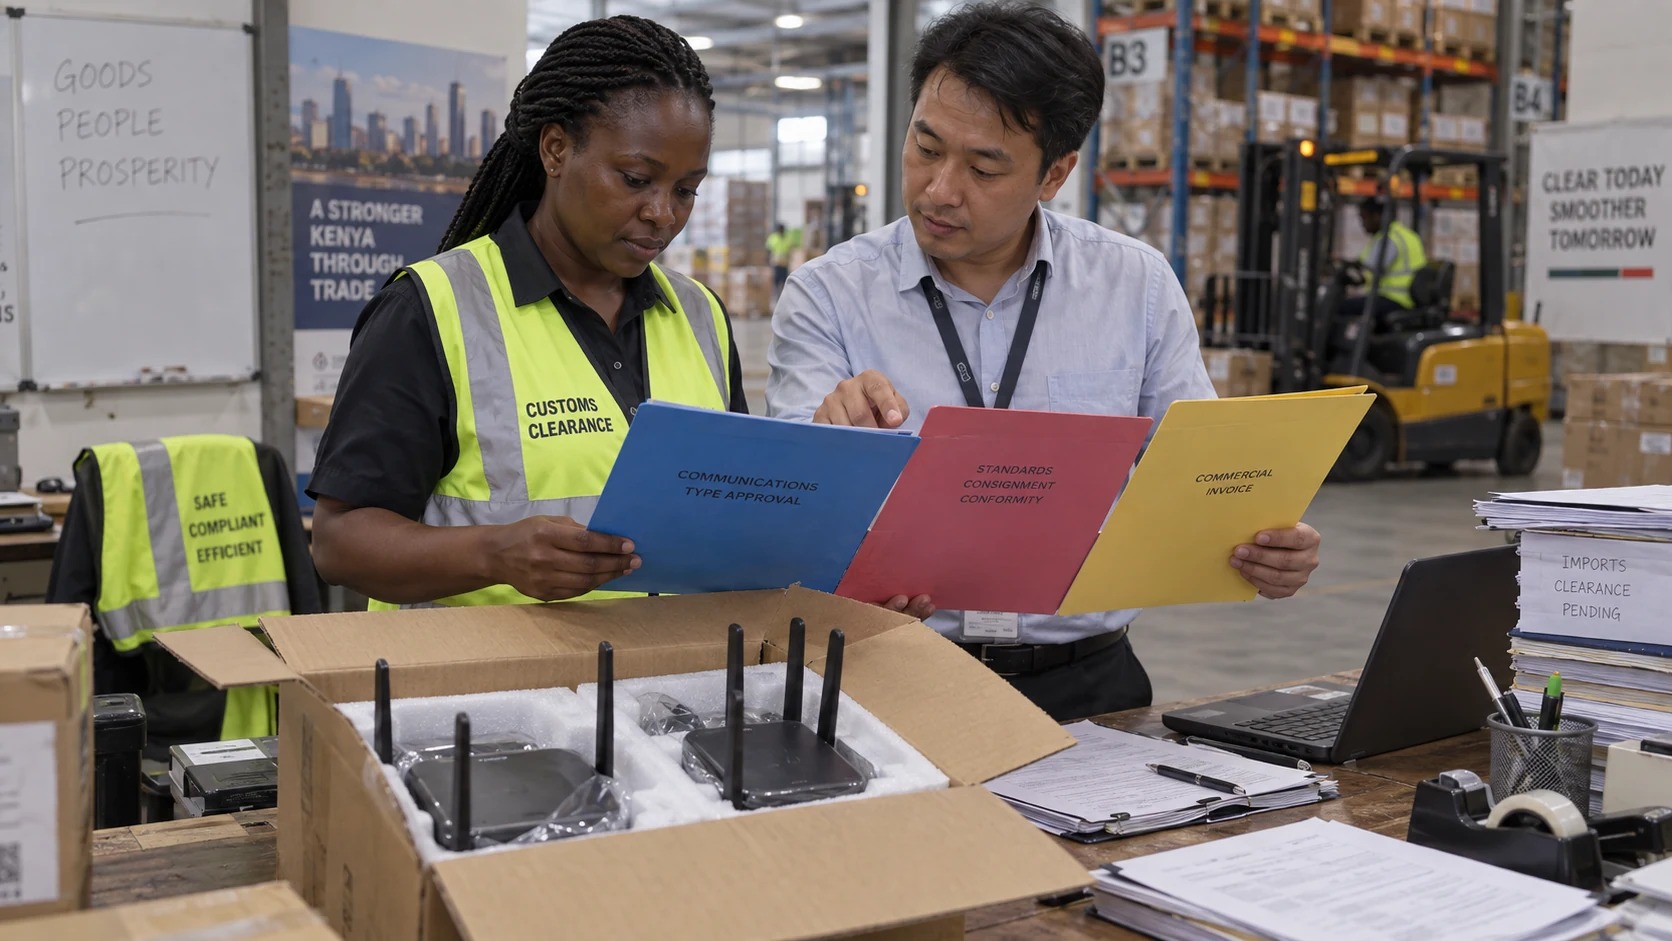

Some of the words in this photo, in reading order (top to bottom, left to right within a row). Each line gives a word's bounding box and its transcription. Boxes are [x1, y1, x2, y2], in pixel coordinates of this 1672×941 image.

[1110, 40, 1147, 77] B3
[54, 58, 153, 95] GOODS
[1515, 82, 1541, 113] B4
[57, 107, 165, 142] PEOPLE
[59, 155, 220, 191] PROSPERITY
[1542, 168, 1600, 194] CLEAR
[1604, 164, 1666, 190] TODAY
[309, 198, 325, 219] A
[327, 200, 424, 225] STRONGER
[1549, 196, 1648, 222] SMOOTHER
[310, 224, 376, 249] KENYA
[1549, 226, 1657, 251] TOMORROW
[310, 252, 404, 275] THROUGH
[310, 279, 376, 301] TRADE
[526, 397, 598, 418] CUSTOMS
[528, 418, 614, 440] CLEARANCE
[677, 470, 819, 492] COMMUNICATIONS
[976, 464, 1054, 476] STANDARDS
[1195, 468, 1274, 483] COMMERCIAL
[963, 479, 1056, 490] CONSIGNMENT
[1205, 484, 1255, 496] INVOICE
[193, 491, 228, 511] SAFE
[685, 486, 723, 499] TYPE
[724, 491, 802, 506] APPROVAL
[960, 495, 1044, 505] CONFORMITY
[188, 512, 265, 538] COMPLIANT
[196, 540, 263, 564] EFFICIENT
[1562, 555, 1627, 573] IMPORTS
[1554, 579, 1631, 597] CLEARANCE
[1562, 602, 1621, 622] PENDING
